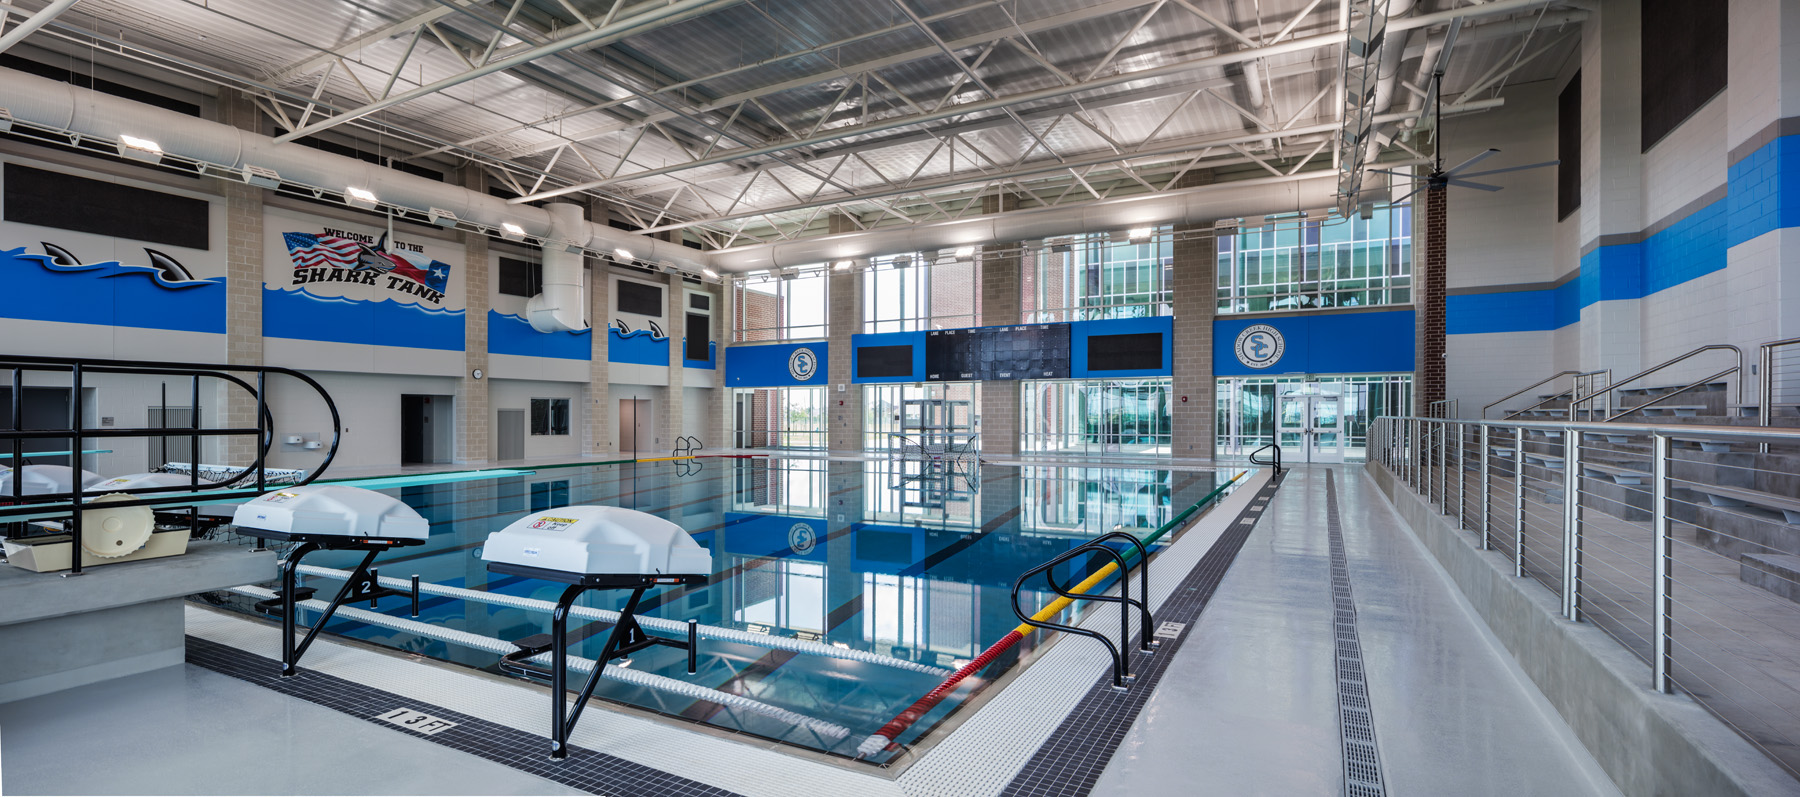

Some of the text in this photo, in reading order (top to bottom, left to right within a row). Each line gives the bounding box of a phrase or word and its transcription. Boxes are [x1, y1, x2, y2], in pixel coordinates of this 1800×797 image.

[324, 227, 424, 253] WELCOME TO THE
[292, 267, 445, 304] SHARK TANK
[361, 581, 371, 594] 2
[629, 627, 635, 643] 1
[418, 720, 452, 732] FT
